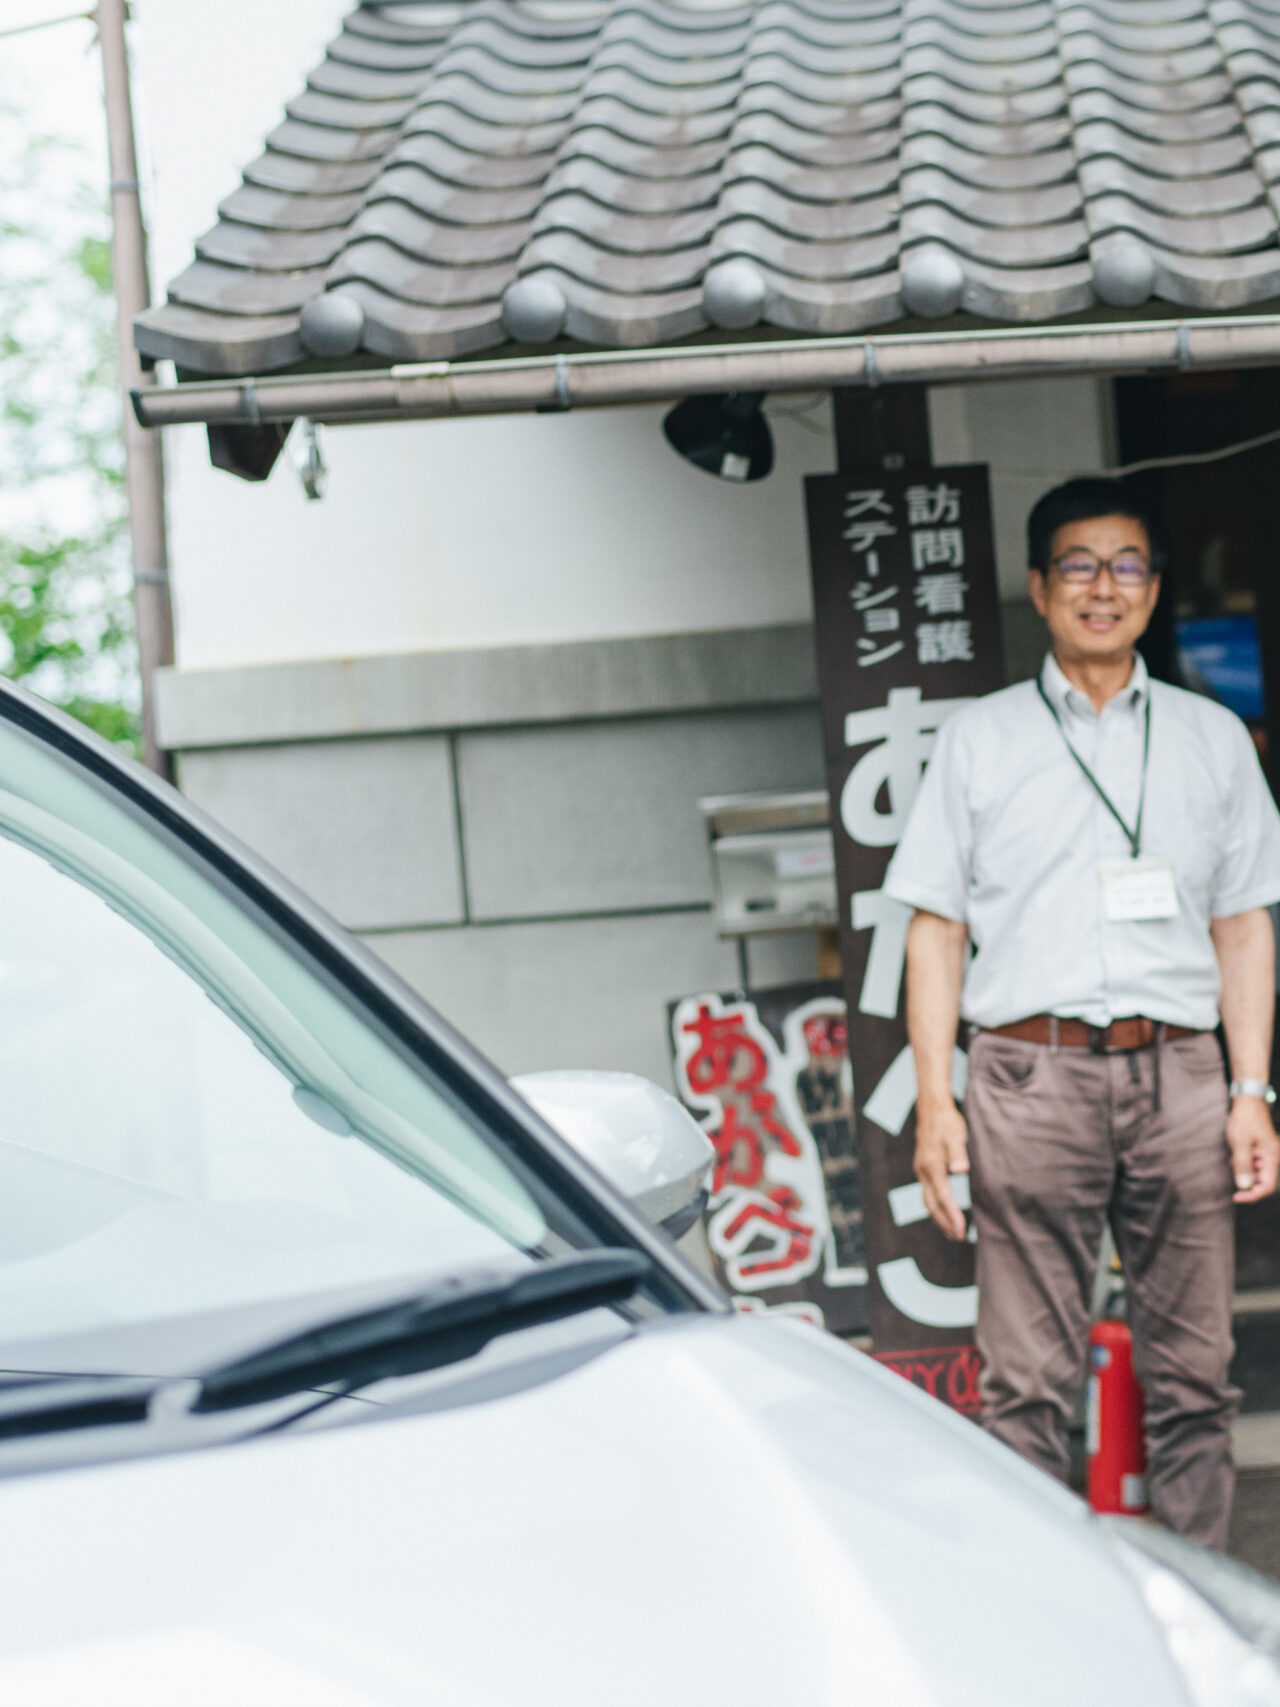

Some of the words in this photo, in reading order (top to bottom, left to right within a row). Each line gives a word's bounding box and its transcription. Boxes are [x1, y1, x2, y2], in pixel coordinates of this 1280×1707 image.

[842, 489, 904, 668] ステーション
[907, 482, 974, 664] 訪問看護
